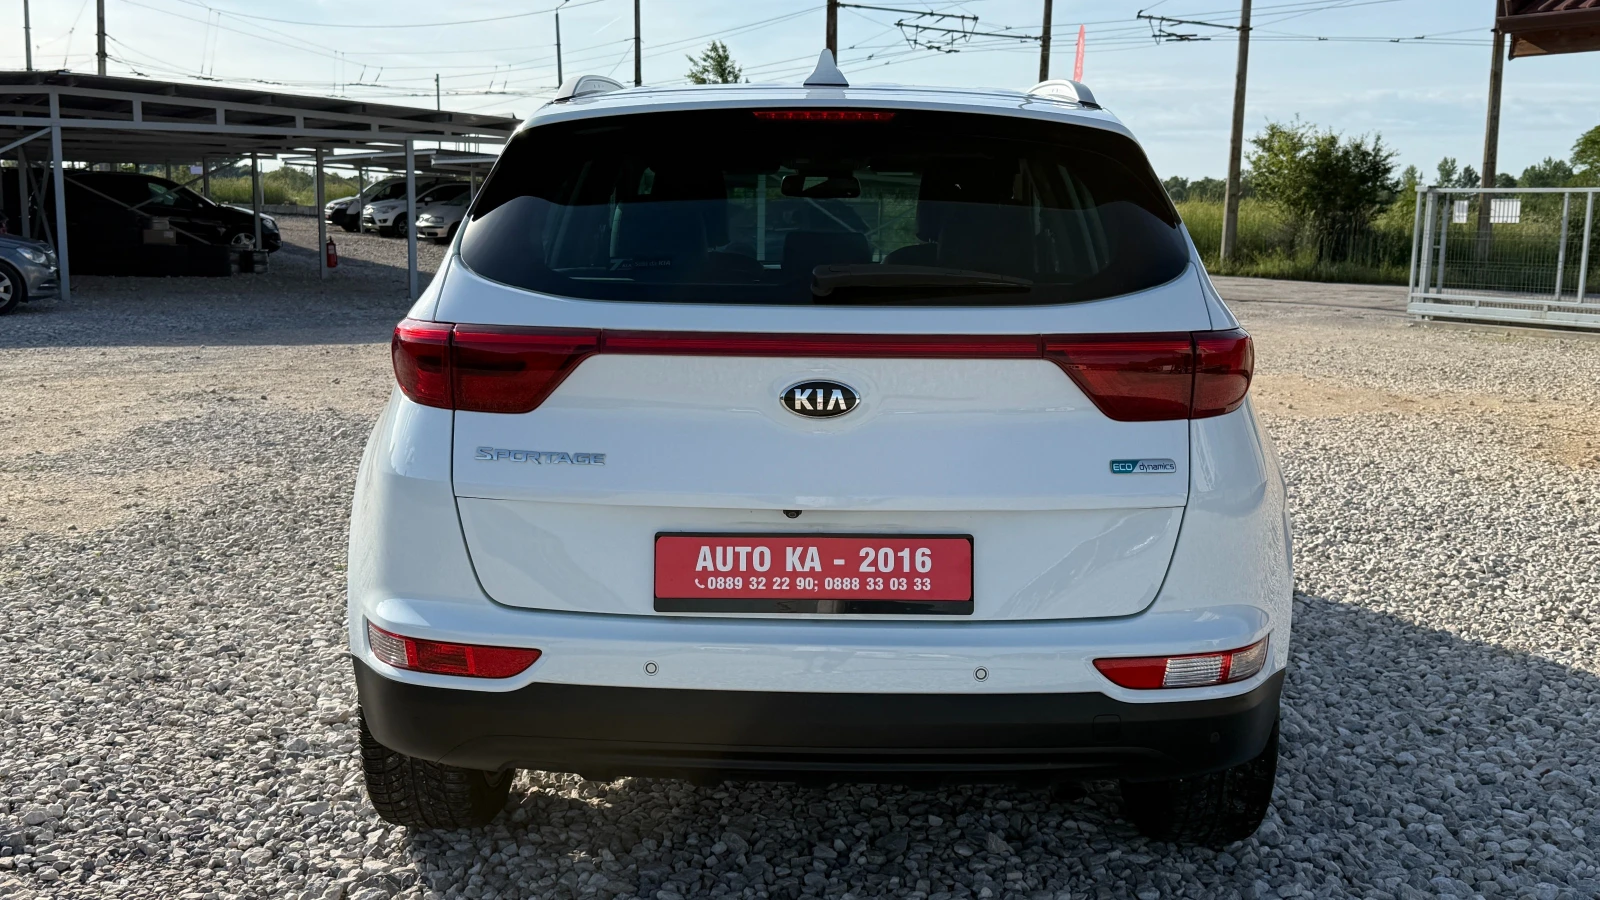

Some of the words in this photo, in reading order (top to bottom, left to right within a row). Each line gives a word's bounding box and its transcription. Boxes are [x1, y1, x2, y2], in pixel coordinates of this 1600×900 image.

[793, 388, 847, 410] KIA
[474, 446, 607, 466] SPORTAGE
[1112, 463, 1133, 471] ECO
[1138, 462, 1175, 472] dynamics
[695, 545, 772, 572] AUTO
[785, 546, 822, 572] KA
[858, 547, 932, 573] 2016
[707, 576, 743, 590] 0889
[748, 576, 767, 590] 32
[772, 576, 790, 590] 22
[795, 577, 819, 592] 90;
[824, 577, 860, 591] 0888
[866, 577, 884, 591] 33
[889, 577, 908, 591] 03
[913, 577, 931, 591] 33
